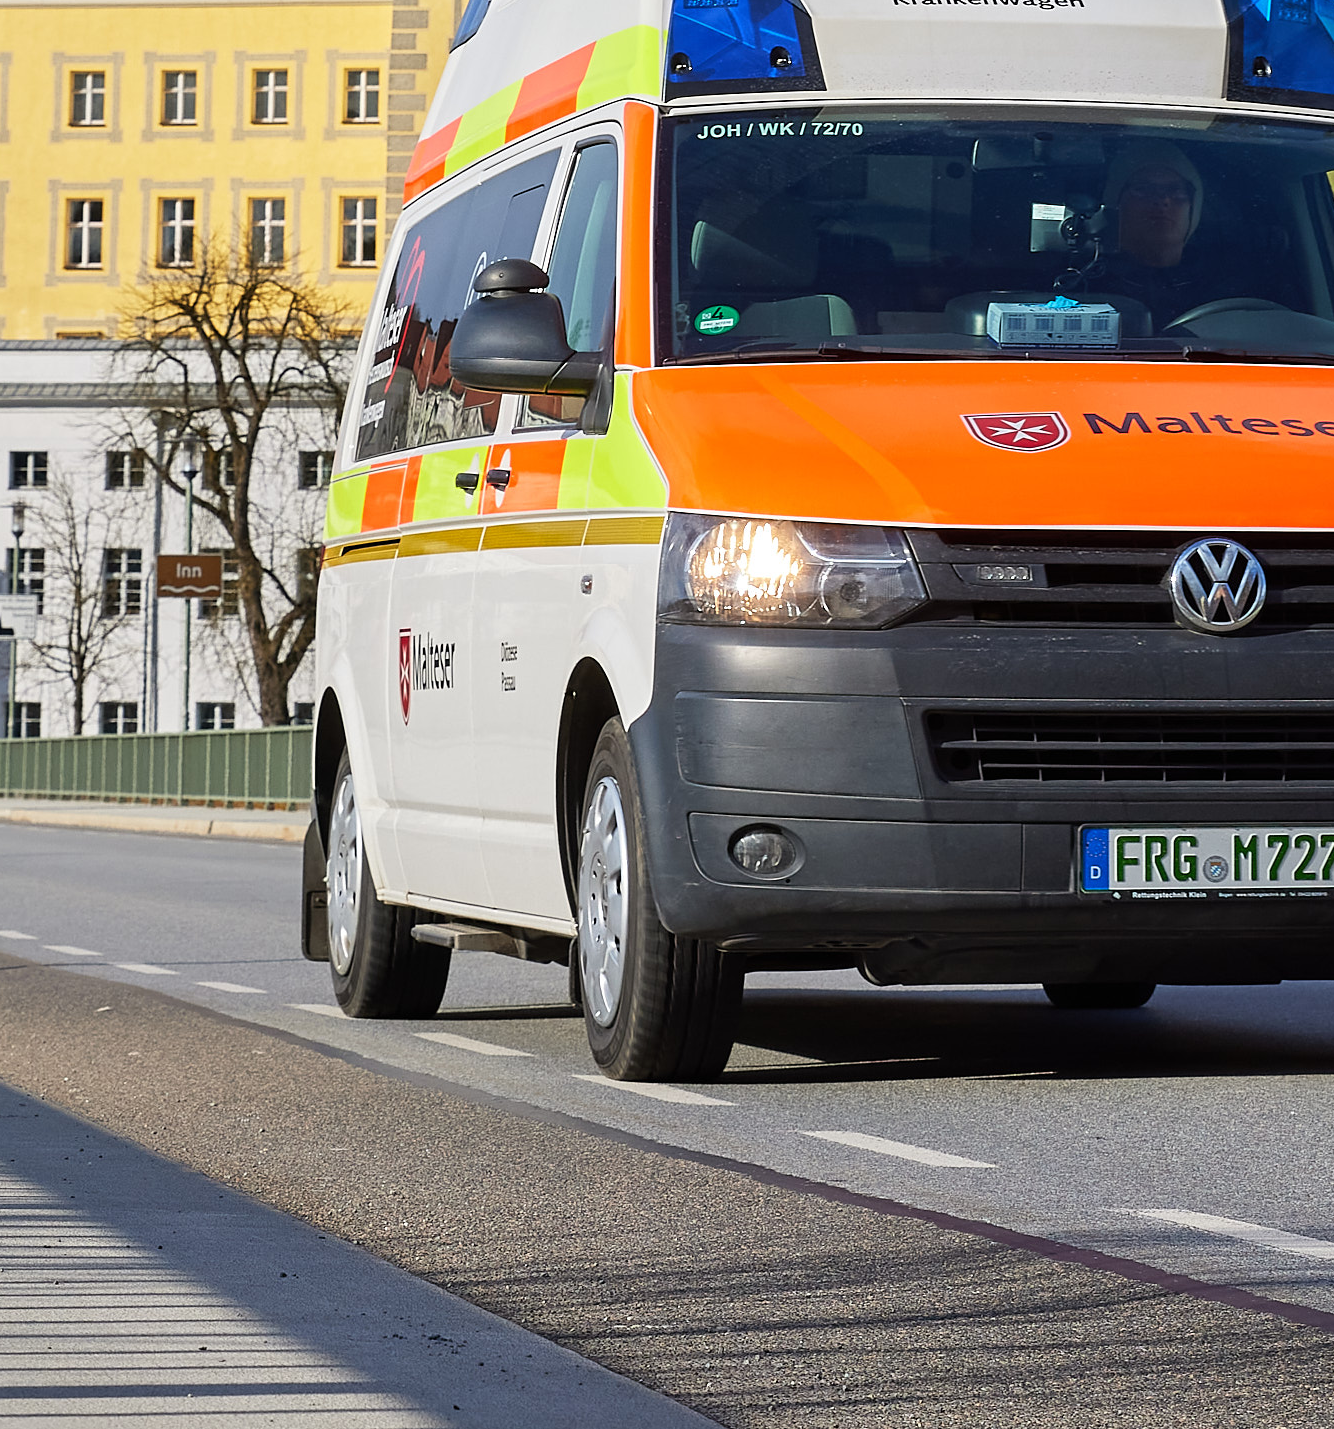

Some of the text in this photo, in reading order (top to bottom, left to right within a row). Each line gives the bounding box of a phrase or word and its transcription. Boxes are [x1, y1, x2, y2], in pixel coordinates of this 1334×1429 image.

[697, 123, 863, 139] JOH / WK / 72/70
[711, 307, 724, 319] 4
[176, 562, 202, 578] Inn
[413, 632, 455, 690] Malteser
[1116, 834, 1198, 882] FRG
[1090, 866, 1102, 879] D
[1132, 891, 1187, 900] Rettungstechnik
